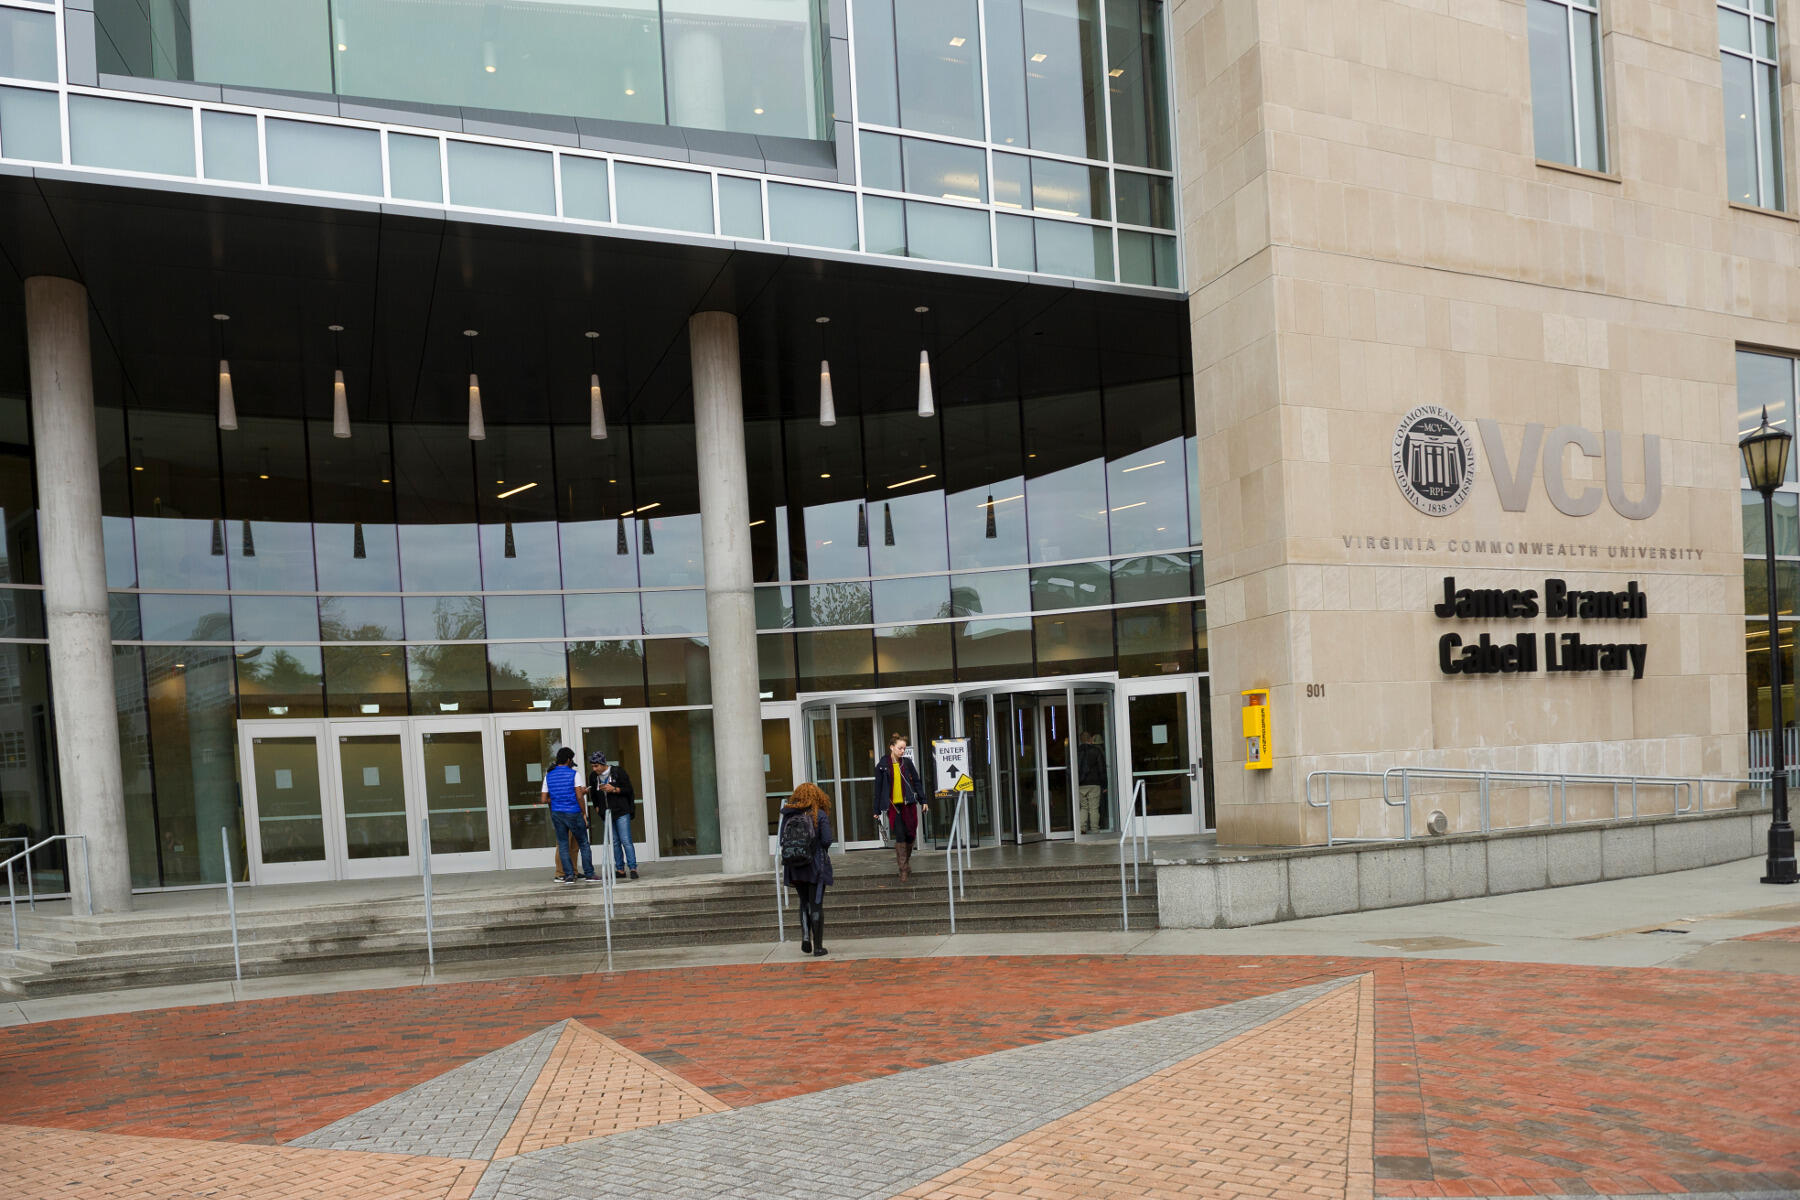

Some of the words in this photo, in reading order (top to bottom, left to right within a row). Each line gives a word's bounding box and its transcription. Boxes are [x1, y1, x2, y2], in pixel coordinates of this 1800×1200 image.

[1395, 405, 1466, 447] COMMONWEALTH
[1423, 422, 1443, 433] MCV
[1393, 451, 1420, 506] VIRGINIA
[1453, 437, 1475, 508] UNIVERSITY
[1477, 417, 1661, 520] VCU
[1428, 503, 1448, 513] 1838
[1429, 487, 1444, 497] RPI
[1342, 535, 1436, 551] VIRGINIA
[1447, 539, 1599, 557] COMMONWEALTH
[1607, 545, 1704, 561] UNIVERSITY
[1434, 576, 1540, 619] James
[1544, 578, 1648, 619] Branch
[1438, 632, 1538, 675] Cabell
[1544, 632, 1648, 680] Library
[1306, 684, 1325, 698] 901
